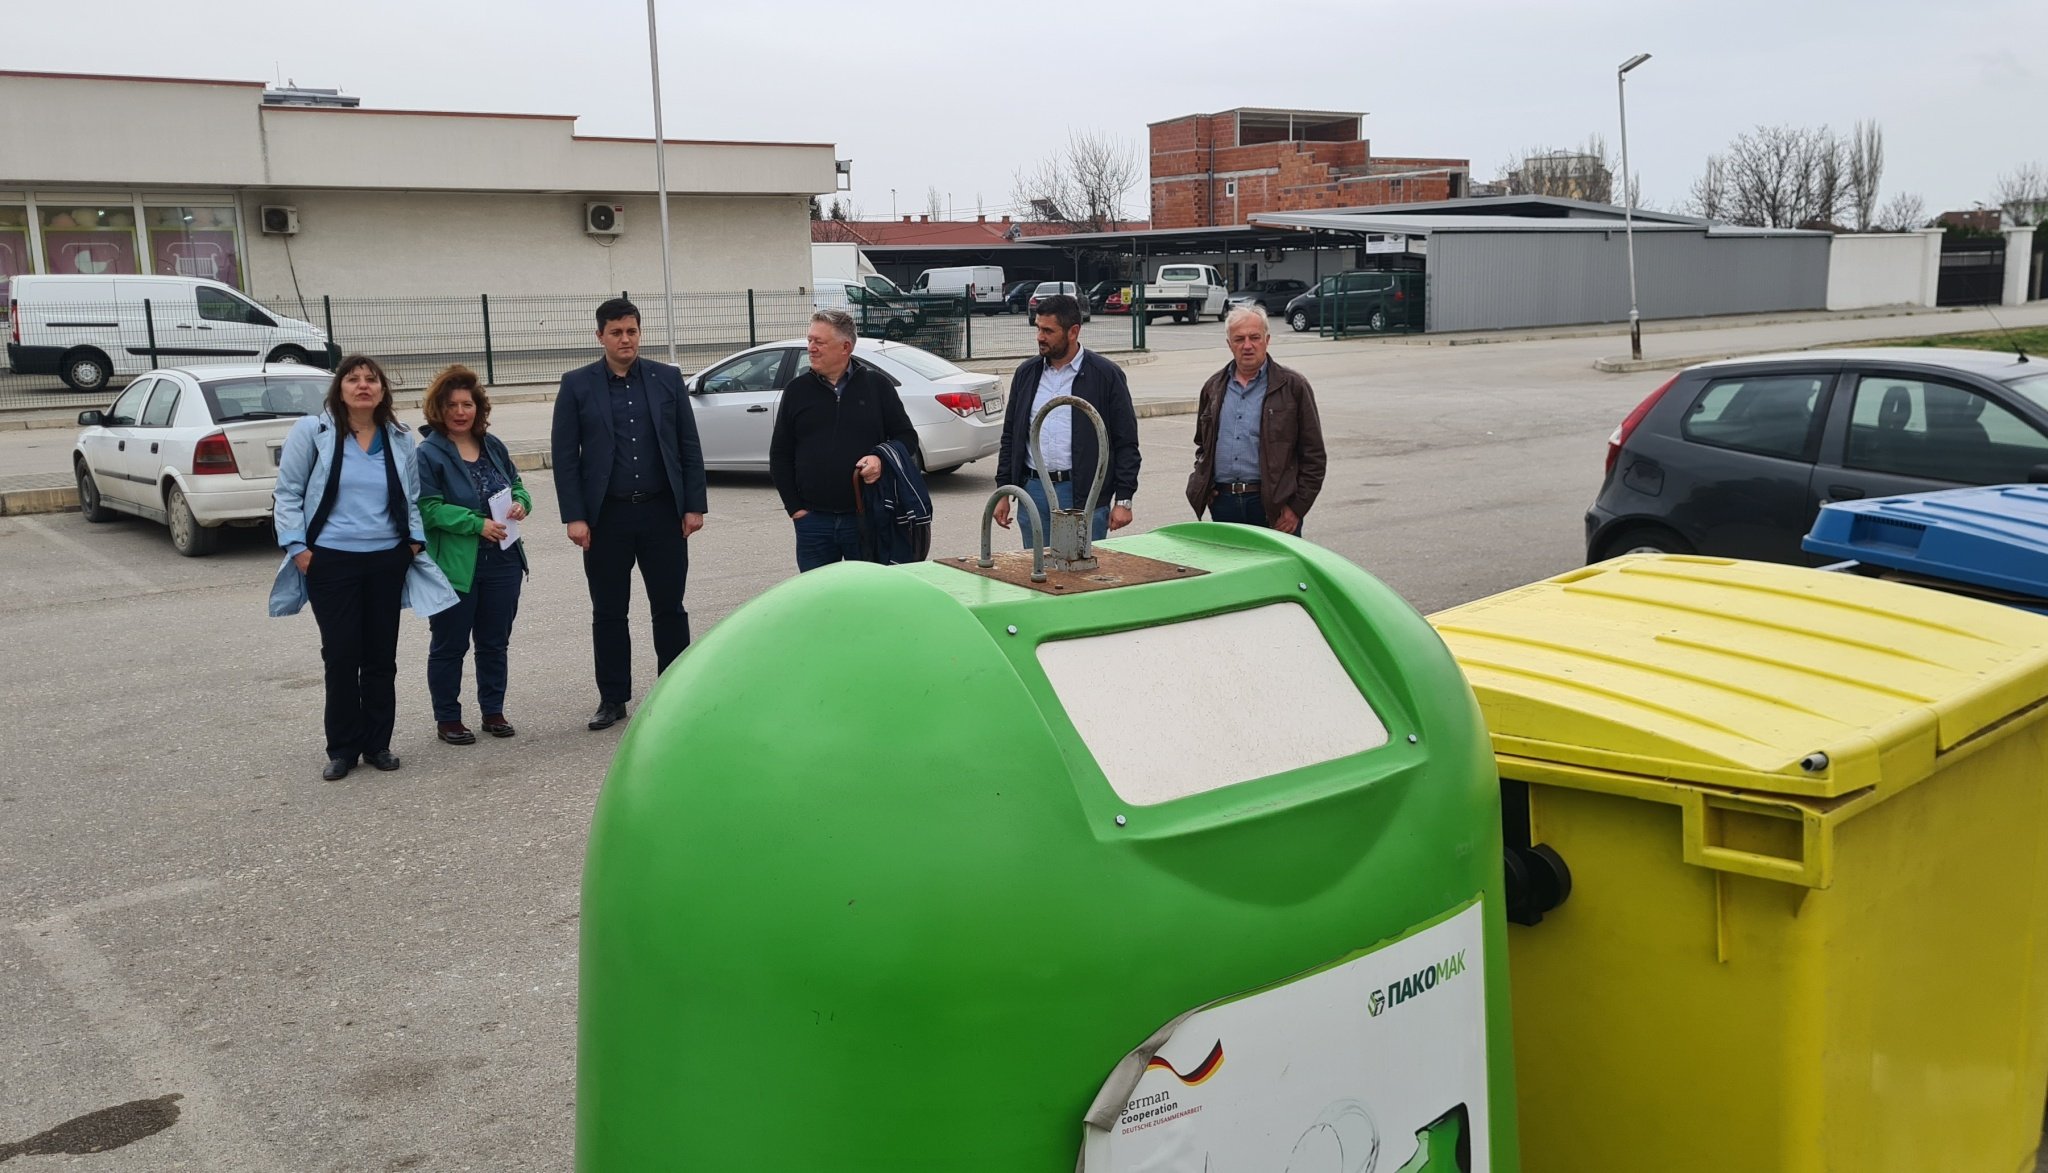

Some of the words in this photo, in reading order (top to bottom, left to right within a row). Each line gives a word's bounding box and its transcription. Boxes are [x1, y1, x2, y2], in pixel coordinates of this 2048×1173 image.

[1388, 948, 1466, 1009] ПАКОМАК
[1121, 1101, 1178, 1124] cooperation
[1121, 1121, 1152, 1135] DEUTSCHE
[1152, 1105, 1203, 1127] ZUSAMMENARBEIT
